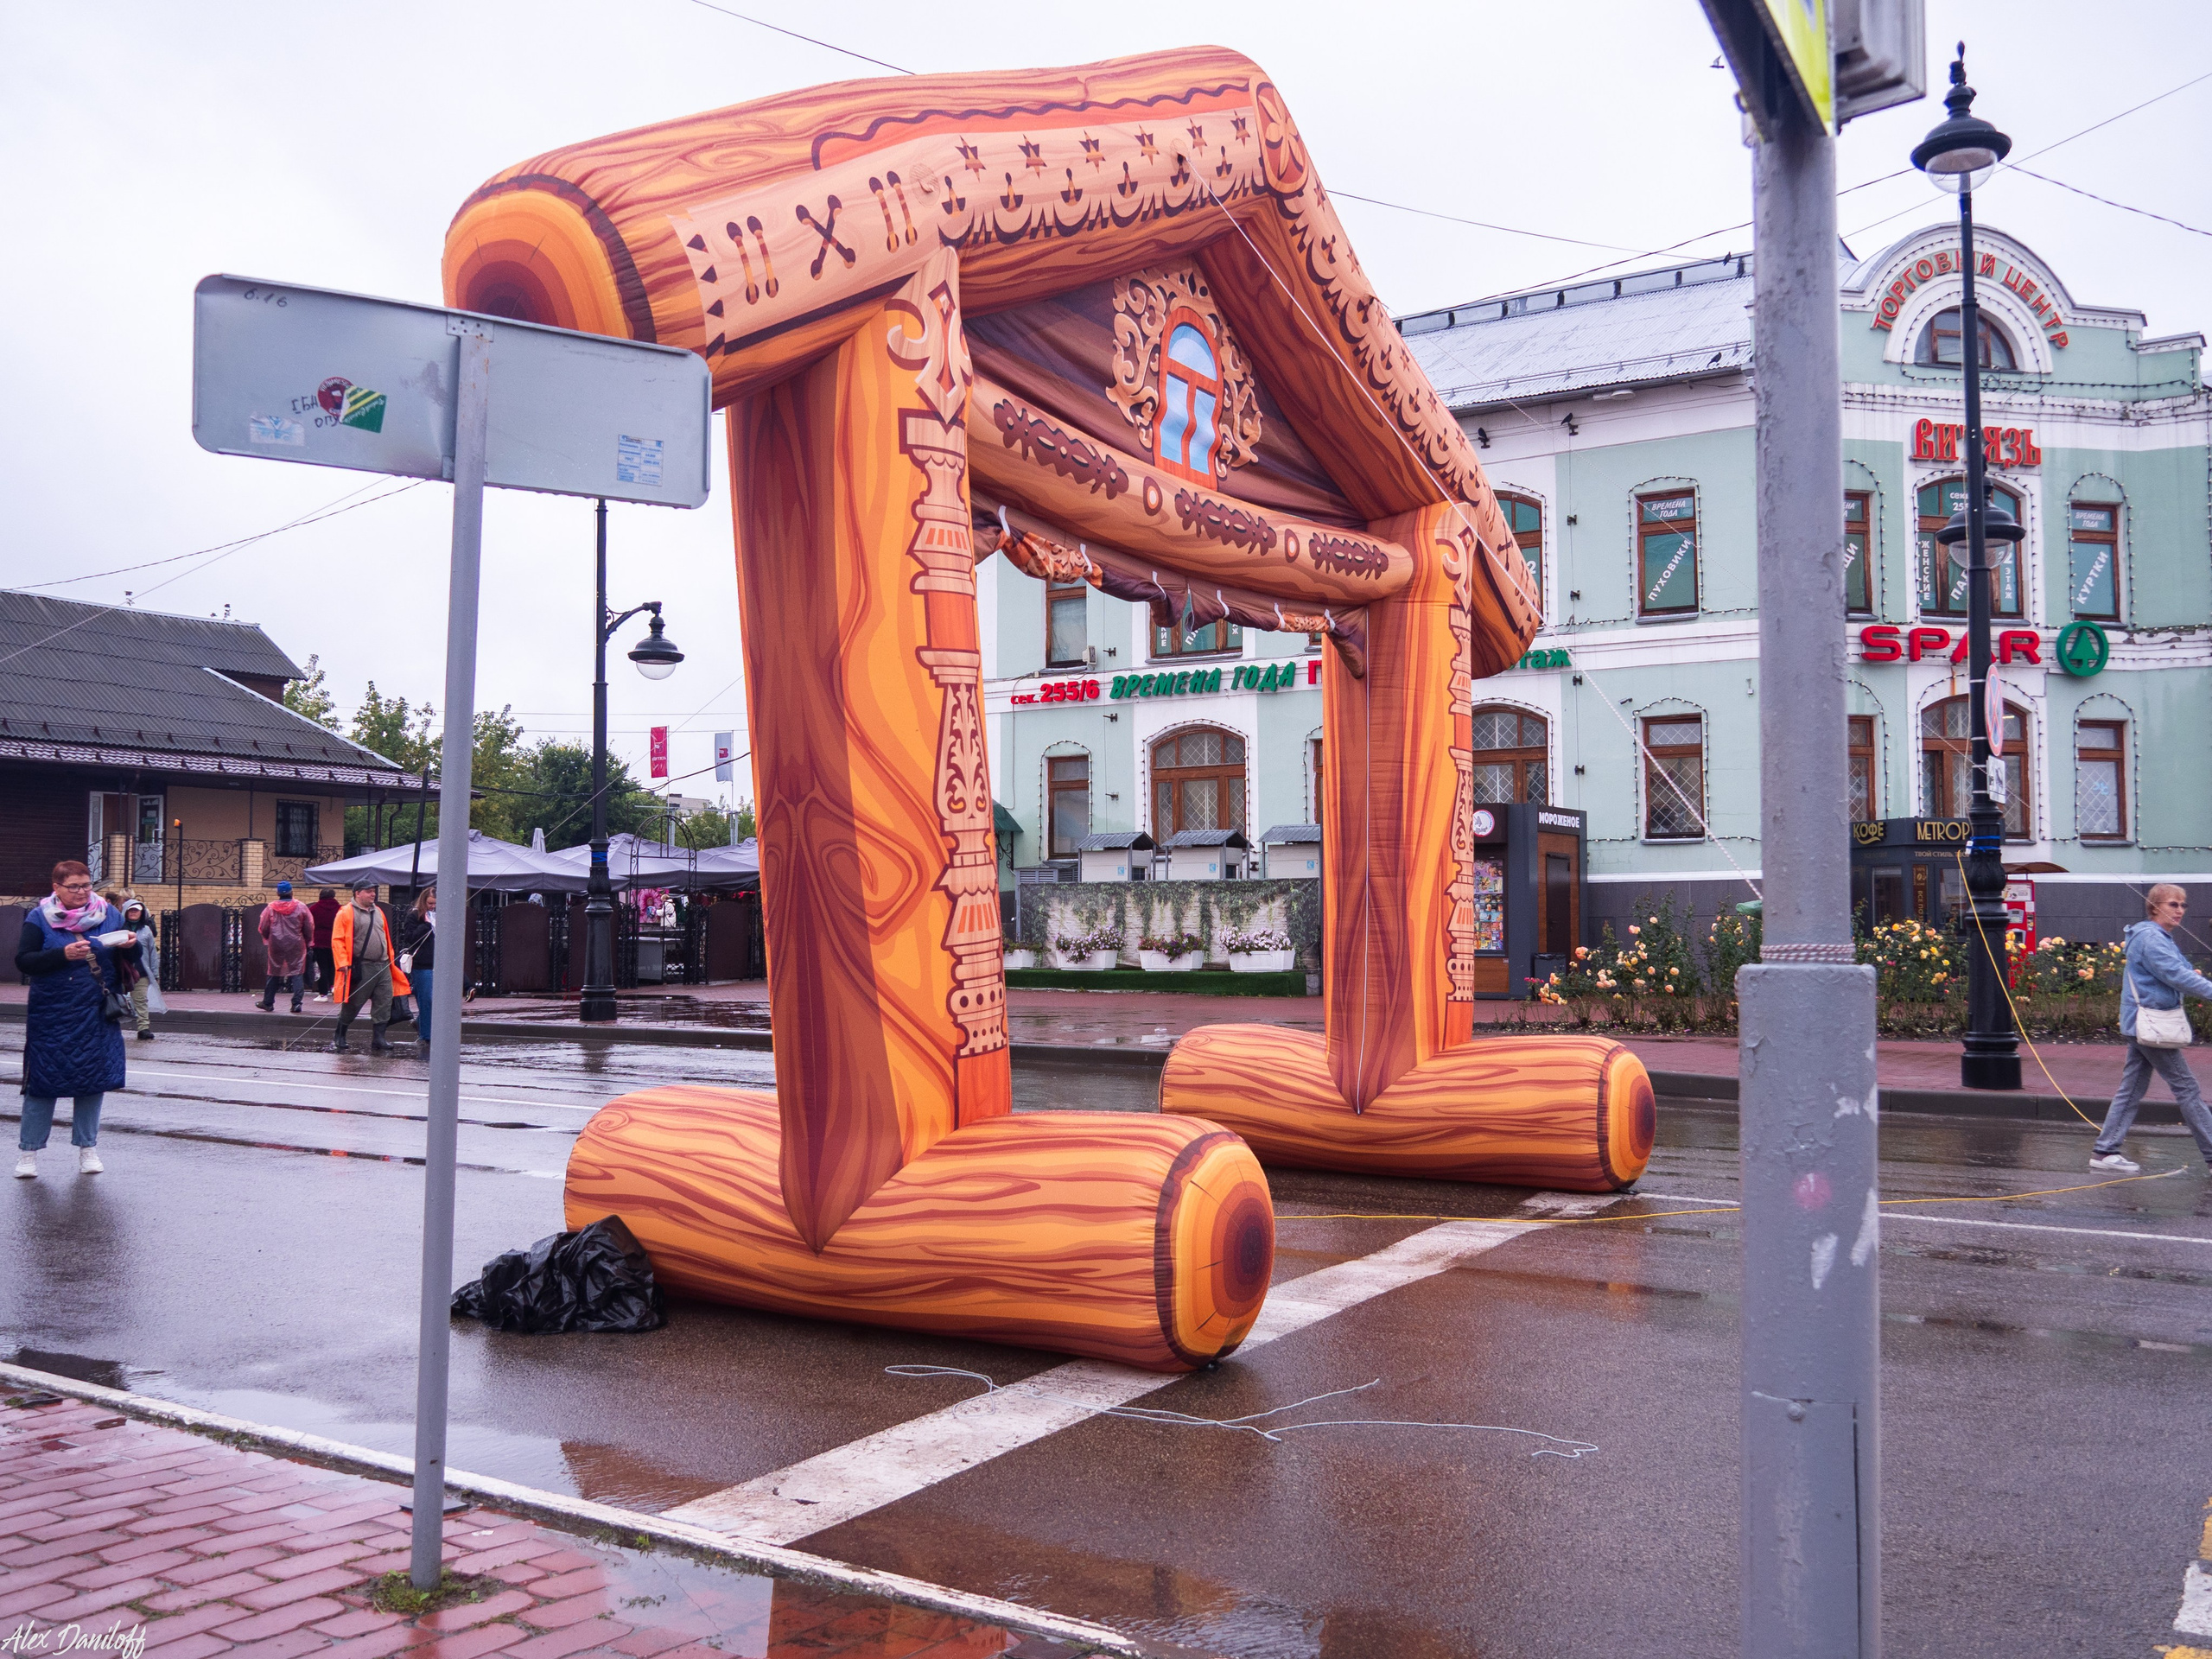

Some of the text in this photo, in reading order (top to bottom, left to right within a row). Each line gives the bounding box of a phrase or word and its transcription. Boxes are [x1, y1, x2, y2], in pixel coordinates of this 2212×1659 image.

[2002, 265, 2069, 348] ЦЕНТР
[1912, 418, 2042, 469] ВИЯЗЬ
[1651, 499, 1686, 511] ВРЕМЕНА
[1659, 509, 1678, 518] ГОДА
[2075, 512, 2106, 520] ВРЕМЕНА
[1648, 538, 1692, 602] ПУХОВИКИ
[1921, 540, 1930, 601] ЖЕНСКИЕ
[2005, 567, 2013, 600] ЭТАЖ
[2076, 550, 2108, 605] КУРТКИ
[1510, 649, 1572, 670] таж
[1040, 679, 1100, 702] 255/6
[1109, 667, 1222, 700] ВРЕМЕНА
[1230, 661, 1296, 692] ГОДА
[1539, 811, 1580, 828] МОРОЖЕНОЕ
[1853, 822, 1885, 838] КОФЕ
